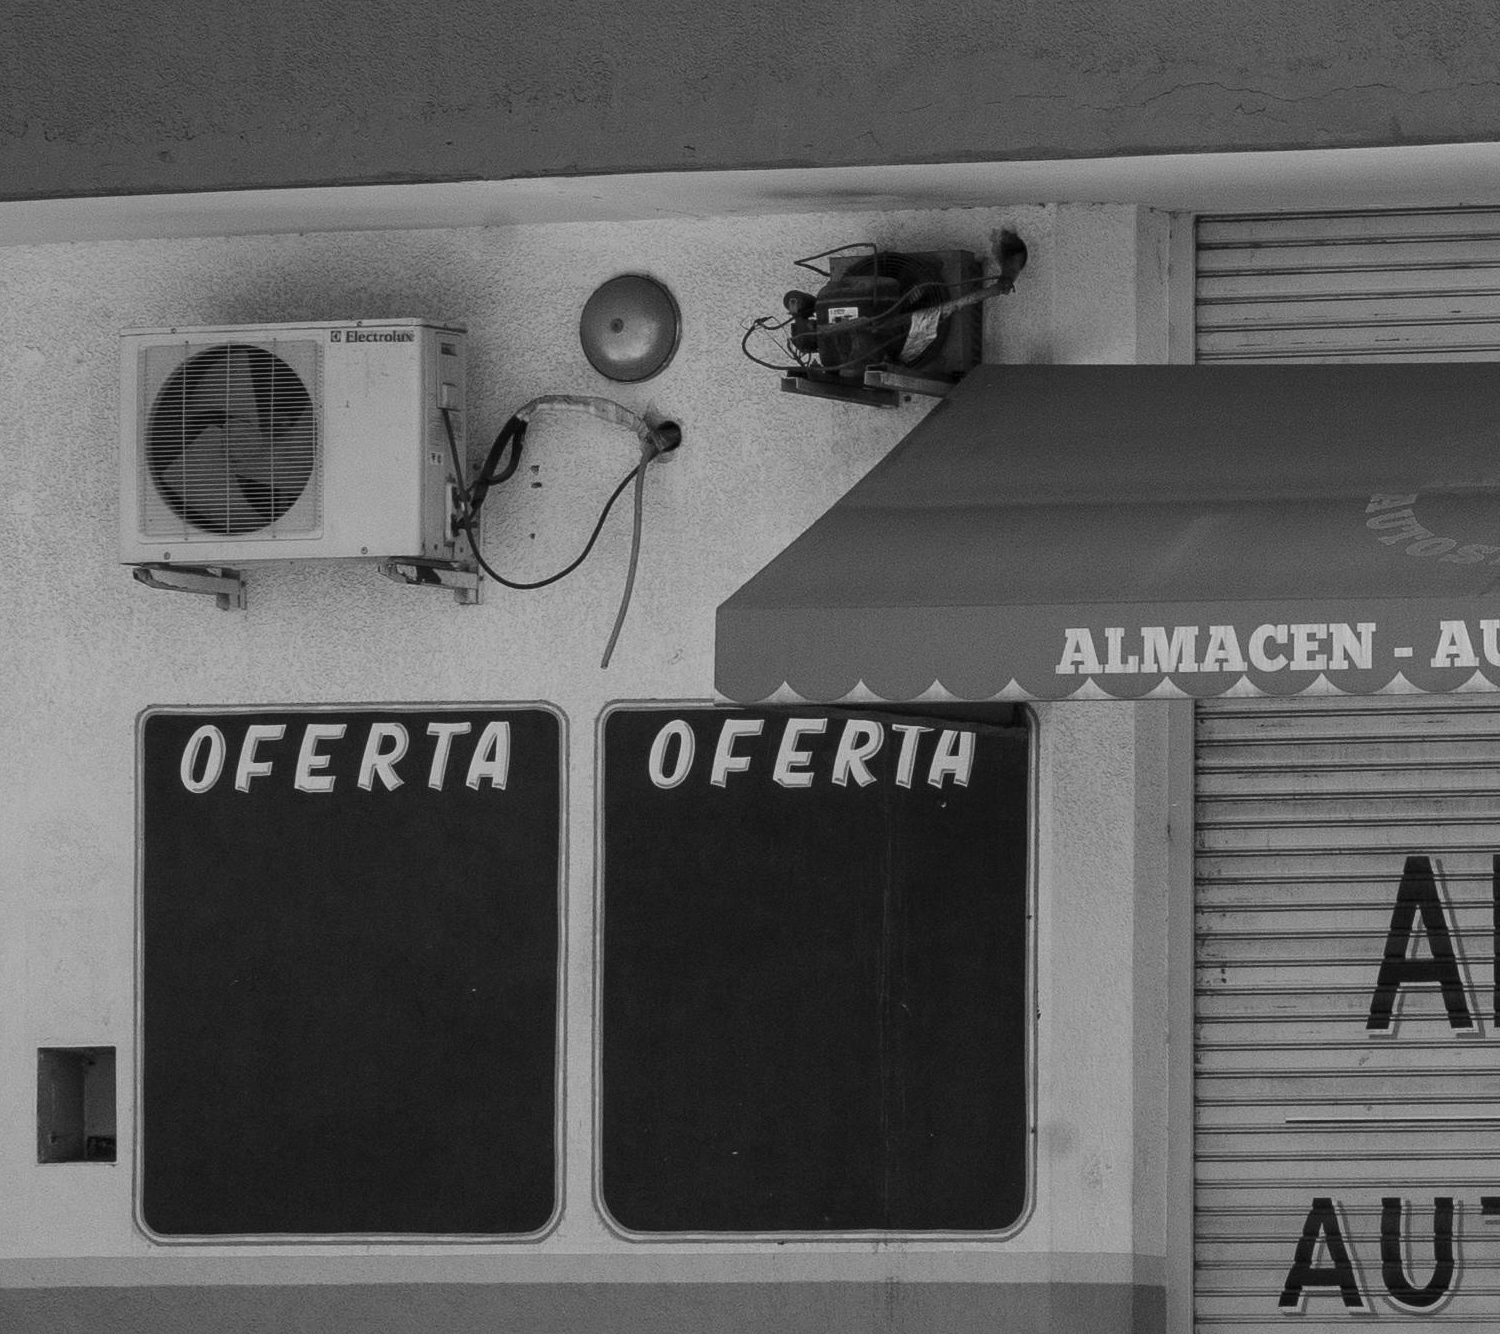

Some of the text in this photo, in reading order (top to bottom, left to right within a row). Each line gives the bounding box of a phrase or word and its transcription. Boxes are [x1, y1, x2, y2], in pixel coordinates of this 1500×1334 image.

[345, 330, 415, 343] Electrolux
[1056, 622, 1377, 675] ALMACEN
[178, 720, 512, 794] OFERTA
[647, 717, 978, 790] OFERTA
